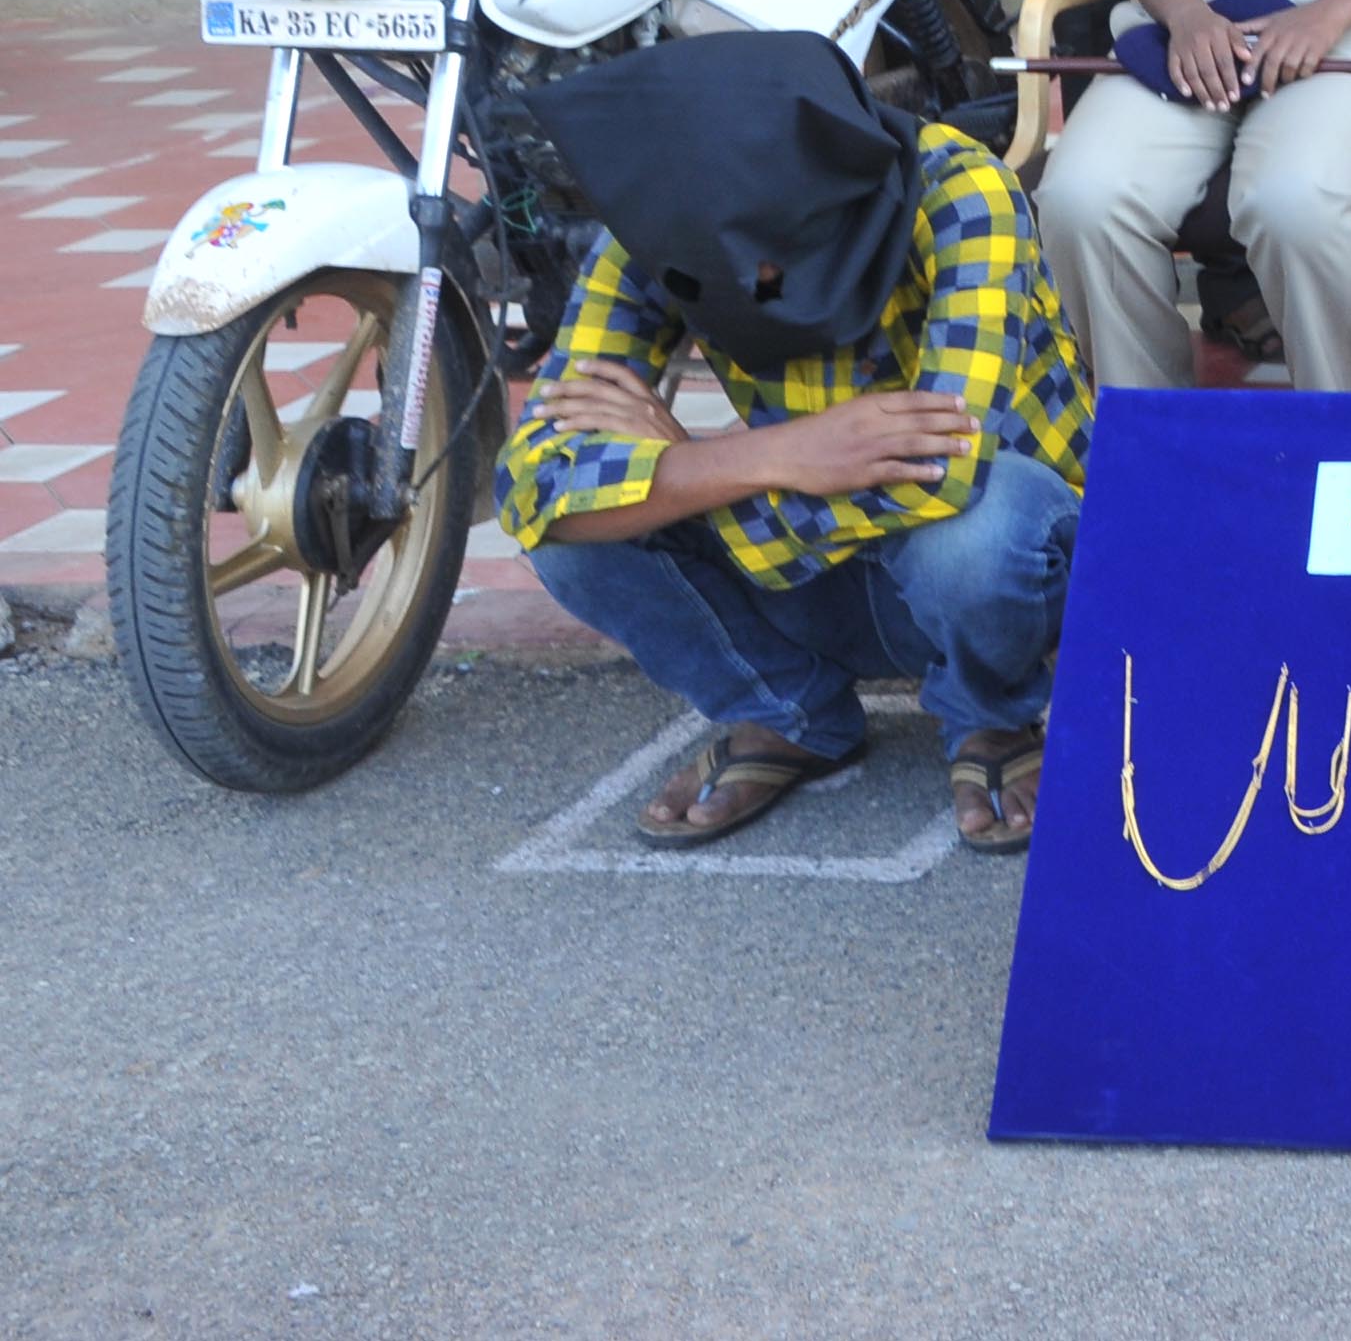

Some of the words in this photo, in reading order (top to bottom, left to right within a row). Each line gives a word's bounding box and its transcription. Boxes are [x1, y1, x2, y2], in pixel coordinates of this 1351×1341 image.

[239, 9, 272, 36] KA
[287, 10, 317, 36] 35
[326, 12, 360, 38] EC
[376, 13, 437, 39] 5655
